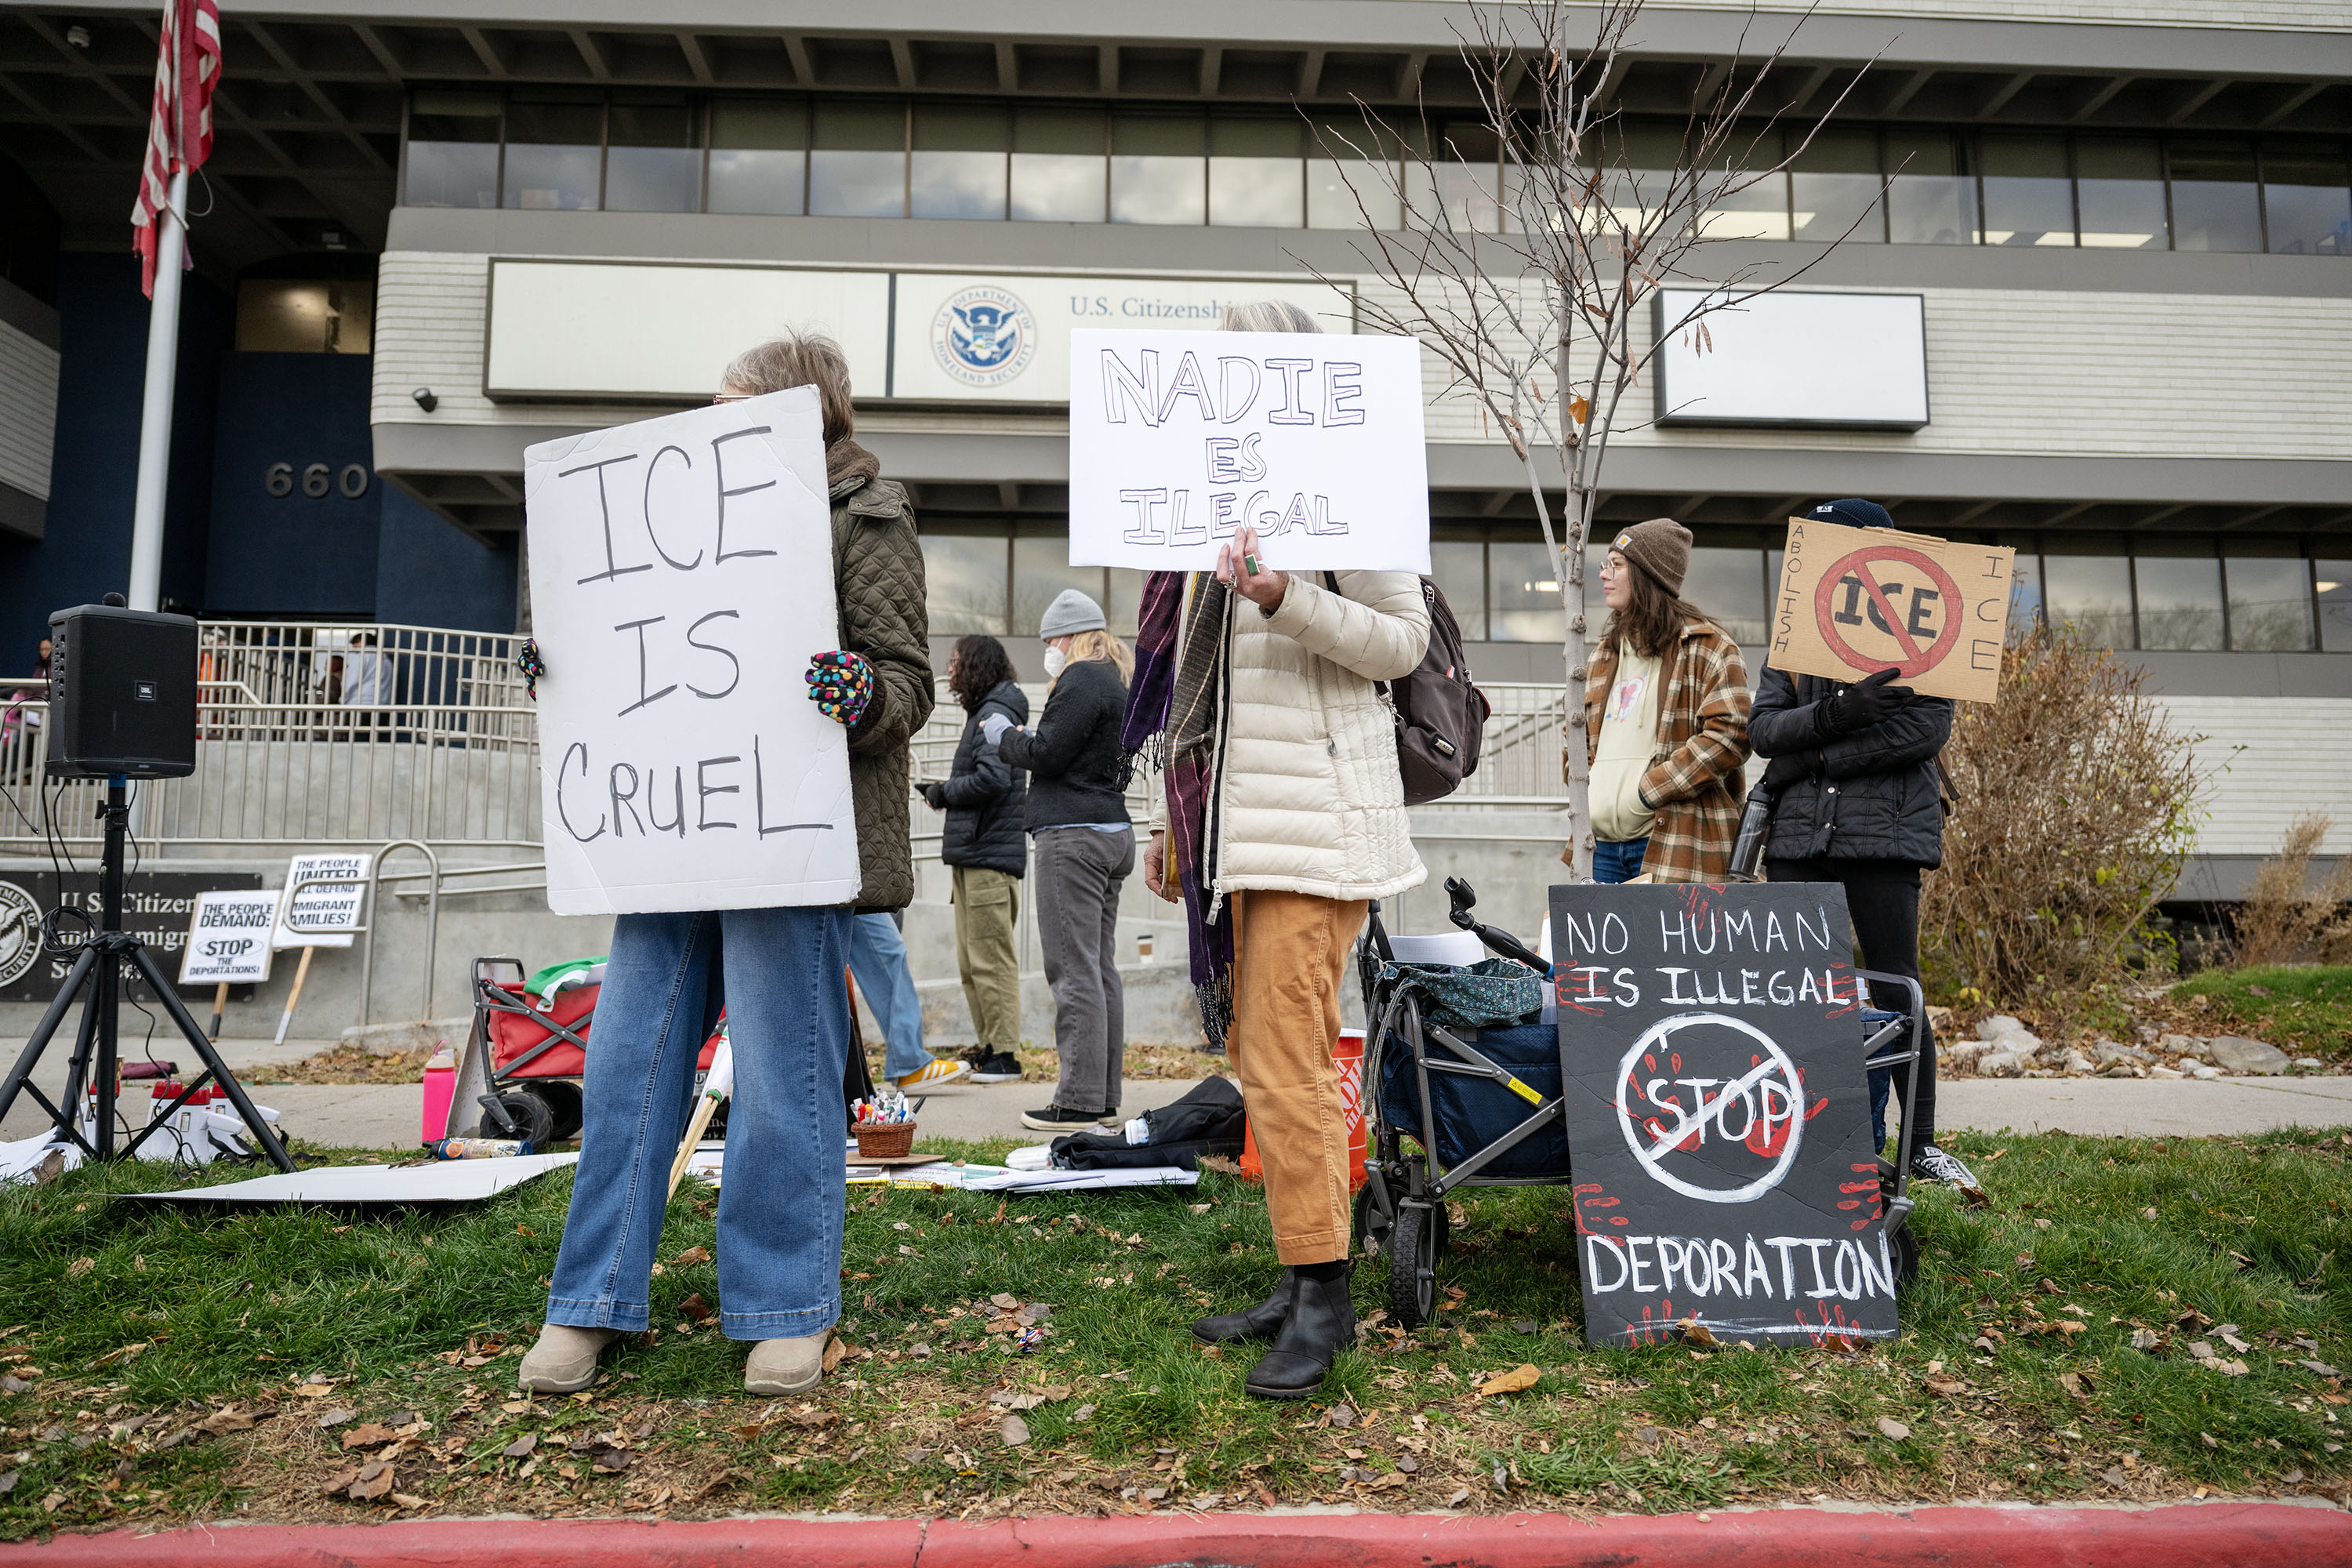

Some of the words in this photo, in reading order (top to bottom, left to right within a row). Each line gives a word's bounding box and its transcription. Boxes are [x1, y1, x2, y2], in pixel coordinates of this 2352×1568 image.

[1070, 296, 1113, 317] U.S.
[1121, 297, 1225, 319] Citizensh
[936, 341, 985, 383] HOMELAND
[989, 343, 1032, 383] SECURITY
[1102, 348, 1365, 428] NADIE
[265, 461, 370, 500] 660
[1206, 432, 1268, 484] ES
[558, 426, 778, 586] ICE
[1120, 487, 1348, 548] ILEGAL
[1773, 524, 1806, 654] ABOLISH
[1834, 575, 1940, 640] ICE
[1970, 555, 2005, 671] ICE
[615, 610, 740, 718] IS
[557, 734, 834, 843] CRUEL
[297, 860, 316, 869] THE
[319, 858, 361, 868] PEOPLE
[26, 913, 38, 928] OF
[200, 914, 271, 927] DEMAND:
[204, 903, 226, 916] THE
[228, 902, 274, 916] PEOPLE
[285, 913, 351, 926] AMILIES!
[1566, 910, 1628, 956] NO
[1660, 905, 1831, 956] HUMAN
[189, 965, 260, 975] DEPORTATIONS!
[205, 938, 253, 956] STOP
[217, 956, 234, 965] THE
[1570, 966, 1640, 1007] IS
[1655, 966, 1852, 1007] ILLEGAL
[1646, 1076, 1798, 1149] STOP
[1585, 1227, 1896, 1301] DEPORATION
